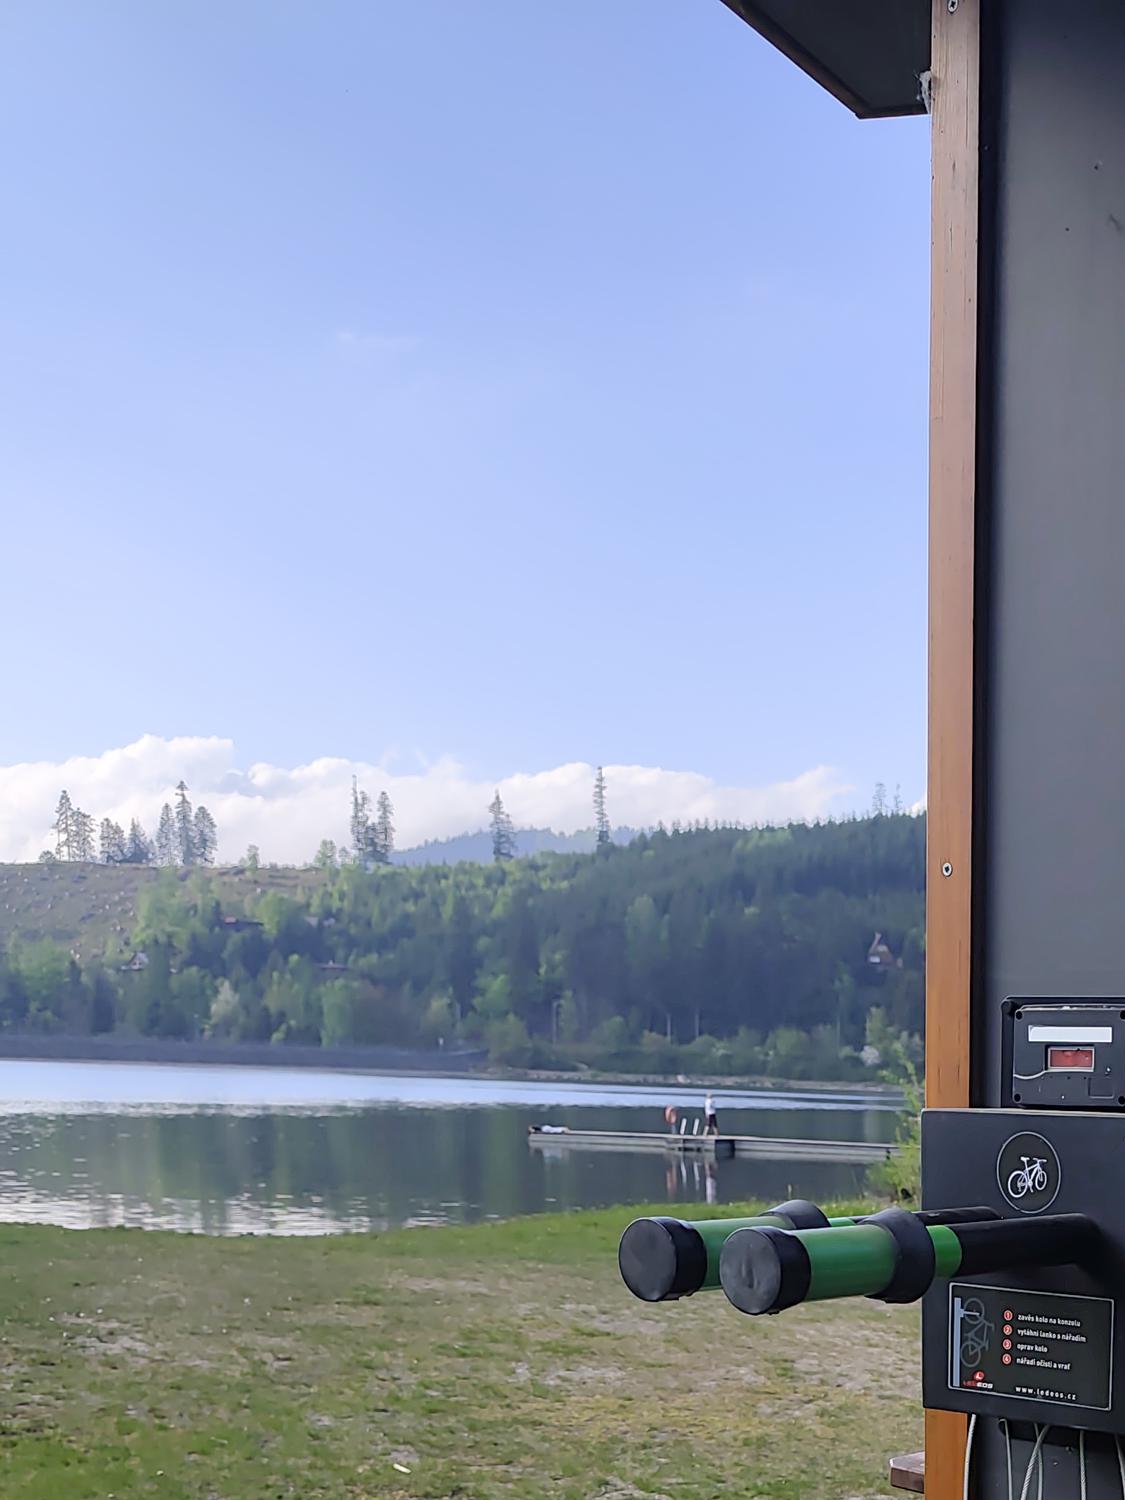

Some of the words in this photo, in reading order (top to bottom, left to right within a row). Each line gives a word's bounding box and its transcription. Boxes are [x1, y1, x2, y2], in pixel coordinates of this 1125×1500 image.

[1018, 1313, 1034, 1322] zavěs
[1035, 1315, 1048, 1323] kolo
[1057, 1318, 1081, 1327] konzolu
[1017, 1328, 1039, 1337] vytáhni
[1040, 1330, 1056, 1339] lanko
[1016, 1343, 1034, 1351] oprav
[1035, 1345, 1048, 1353] kolo
[1015, 1386, 1076, 1400] www.ledeos.cz
